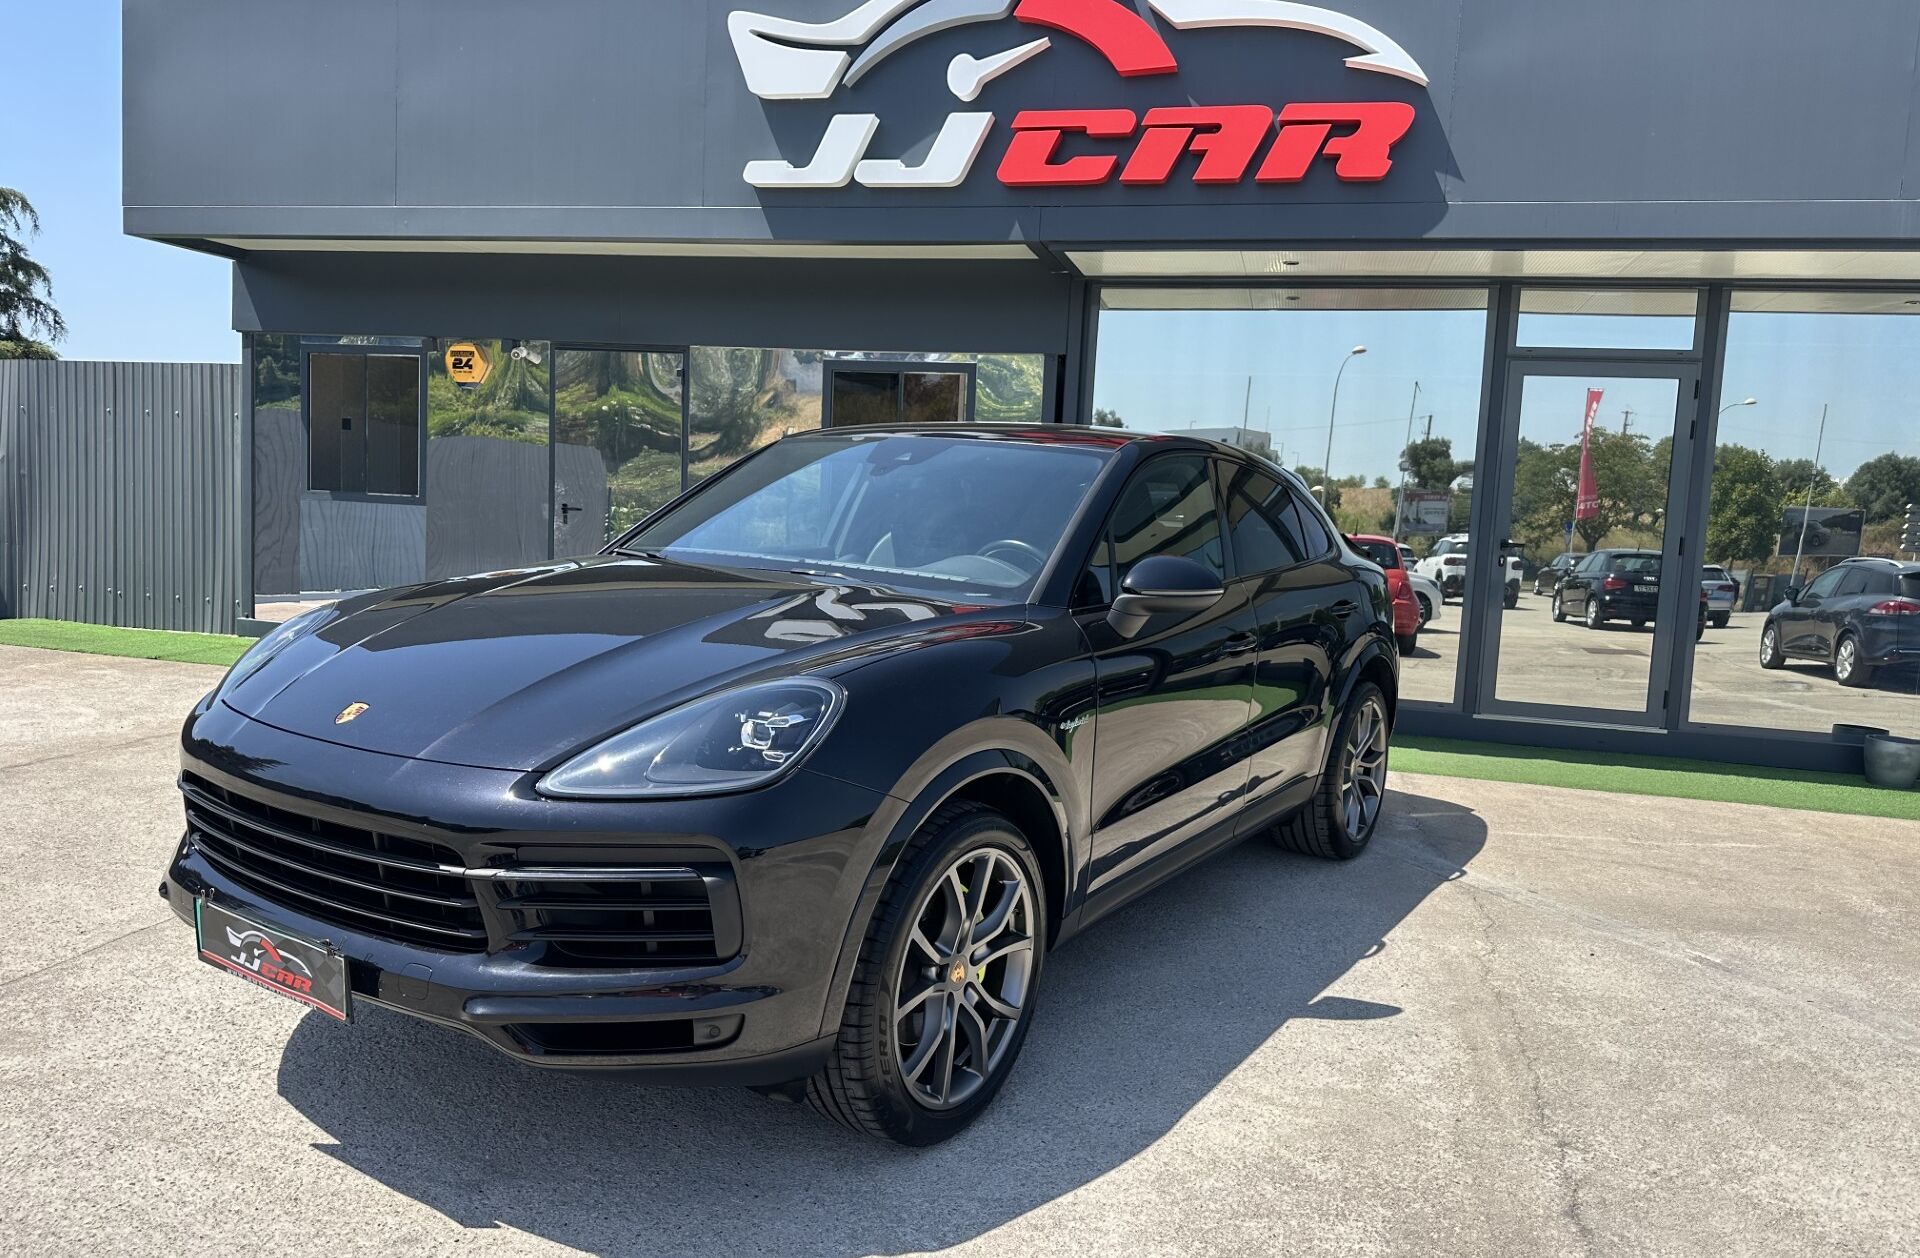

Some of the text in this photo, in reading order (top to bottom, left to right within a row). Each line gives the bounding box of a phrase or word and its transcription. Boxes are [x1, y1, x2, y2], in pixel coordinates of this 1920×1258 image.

[996, 101, 1416, 185] CAR
[452, 357, 473, 369] 24
[260, 963, 312, 992] CAR
